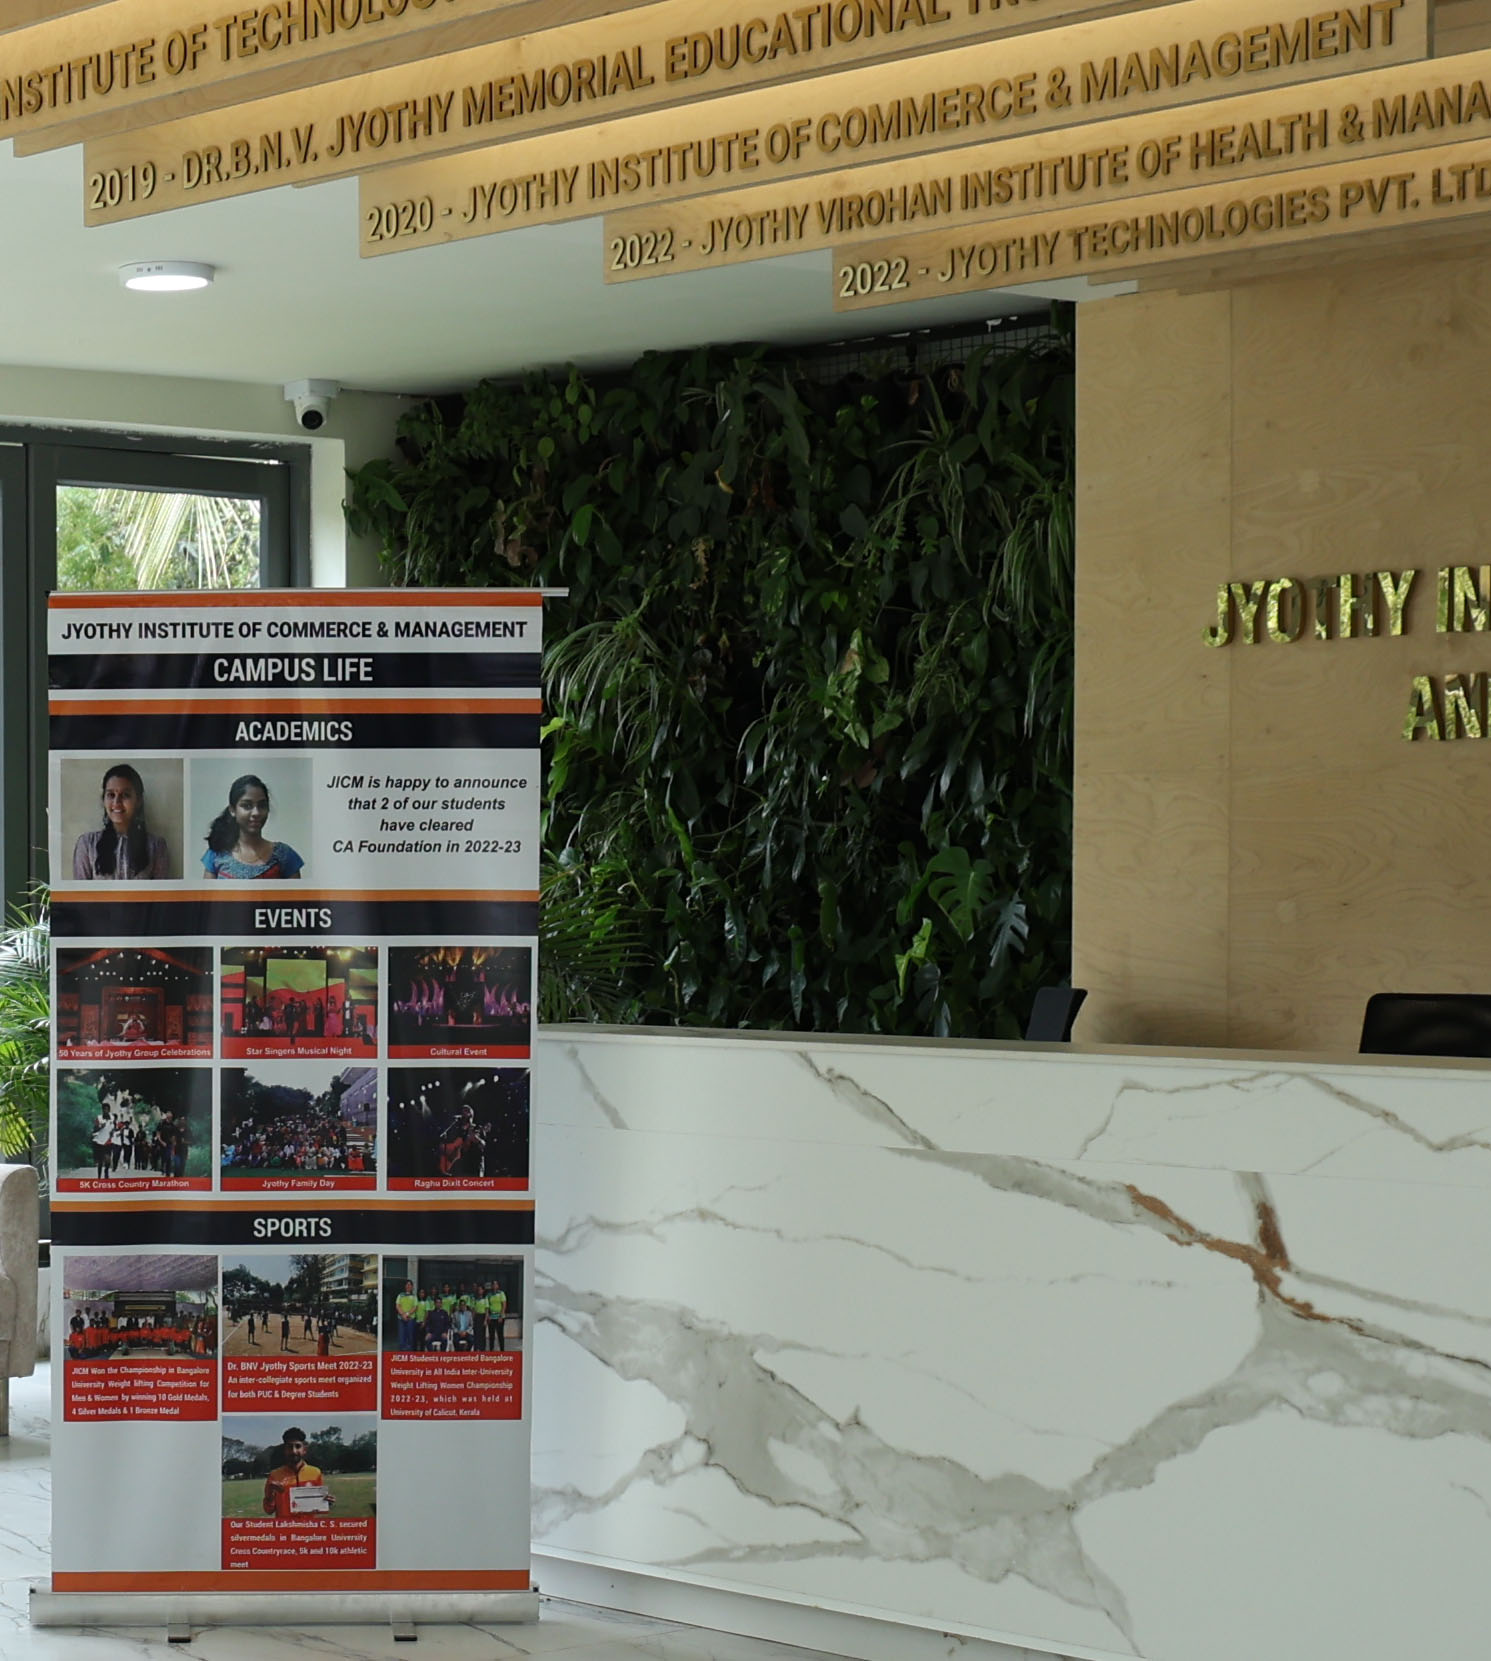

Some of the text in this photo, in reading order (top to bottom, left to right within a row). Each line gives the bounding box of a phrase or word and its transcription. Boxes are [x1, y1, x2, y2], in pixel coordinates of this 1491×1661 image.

[167, 24, 208, 76] OF
[89, 161, 156, 211] 2019
[182, 124, 318, 191] DR.B.N.V.
[326, 90, 454, 158] JYOTHY
[462, 45, 654, 128] MEMORIAL
[366, 1, 1404, 243] 2020 JYOTHY INSTITUTE OF COMMERCE & MANAGEMENT
[611, 228, 674, 271] 2022
[699, 203, 808, 256] JYOTHY
[818, 178, 953, 236] VIROHAN
[961, 145, 1129, 211] INSTITUTE
[1136, 135, 1182, 179] OF
[1189, 105, 1328, 170] HEALTH
[1337, 104, 1365, 144] &
[839, 256, 910, 298] 2022
[937, 229, 1060, 282] JYOTHY
[1072, 186, 1330, 261] TECHNOLOGIES
[1340, 172, 1420, 219] PVT.
[1201, 568, 1417, 647] JYOTHY
[61, 621, 528, 640] JYOTHY INSTITUTE OF COMMERCE & MANAGEMENT
[214, 658, 373, 682] CAMPUS LIFE
[235, 721, 353, 742] ACADEMICS
[326, 776, 527, 792] JICM is happy to announce
[348, 797, 505, 810] that 2 of our students
[380, 819, 474, 831] have cleared
[333, 840, 521, 853] CA Foundation in 2022-23
[254, 908, 332, 929] EVENTS
[95, 1049, 103, 1057] of
[105, 1049, 132, 1058] Jyothy
[134, 1049, 159, 1058] Group
[161, 1048, 211, 1056] Celebrations
[246, 1047, 352, 1056] Star Singers Musical Night
[430, 1048, 488, 1056] Cultural Event
[80, 1179, 190, 1190] 5K Cross Country Marathon
[262, 1179, 335, 1189] Jyothy Family Day
[415, 1179, 494, 1188] Raghu Dixit Concert
[252, 1217, 332, 1238] SPORTS
[228, 1361, 373, 1372] Dr. BNV Jyothy Sports Meet 2022-23
[228, 1376, 237, 1384] An
[239, 1376, 292, 1385] inter-collegiate
[294, 1376, 316, 1384] sports
[337, 1376, 372, 1384] organized
[228, 1390, 339, 1399] for both PUC & Degree Students
